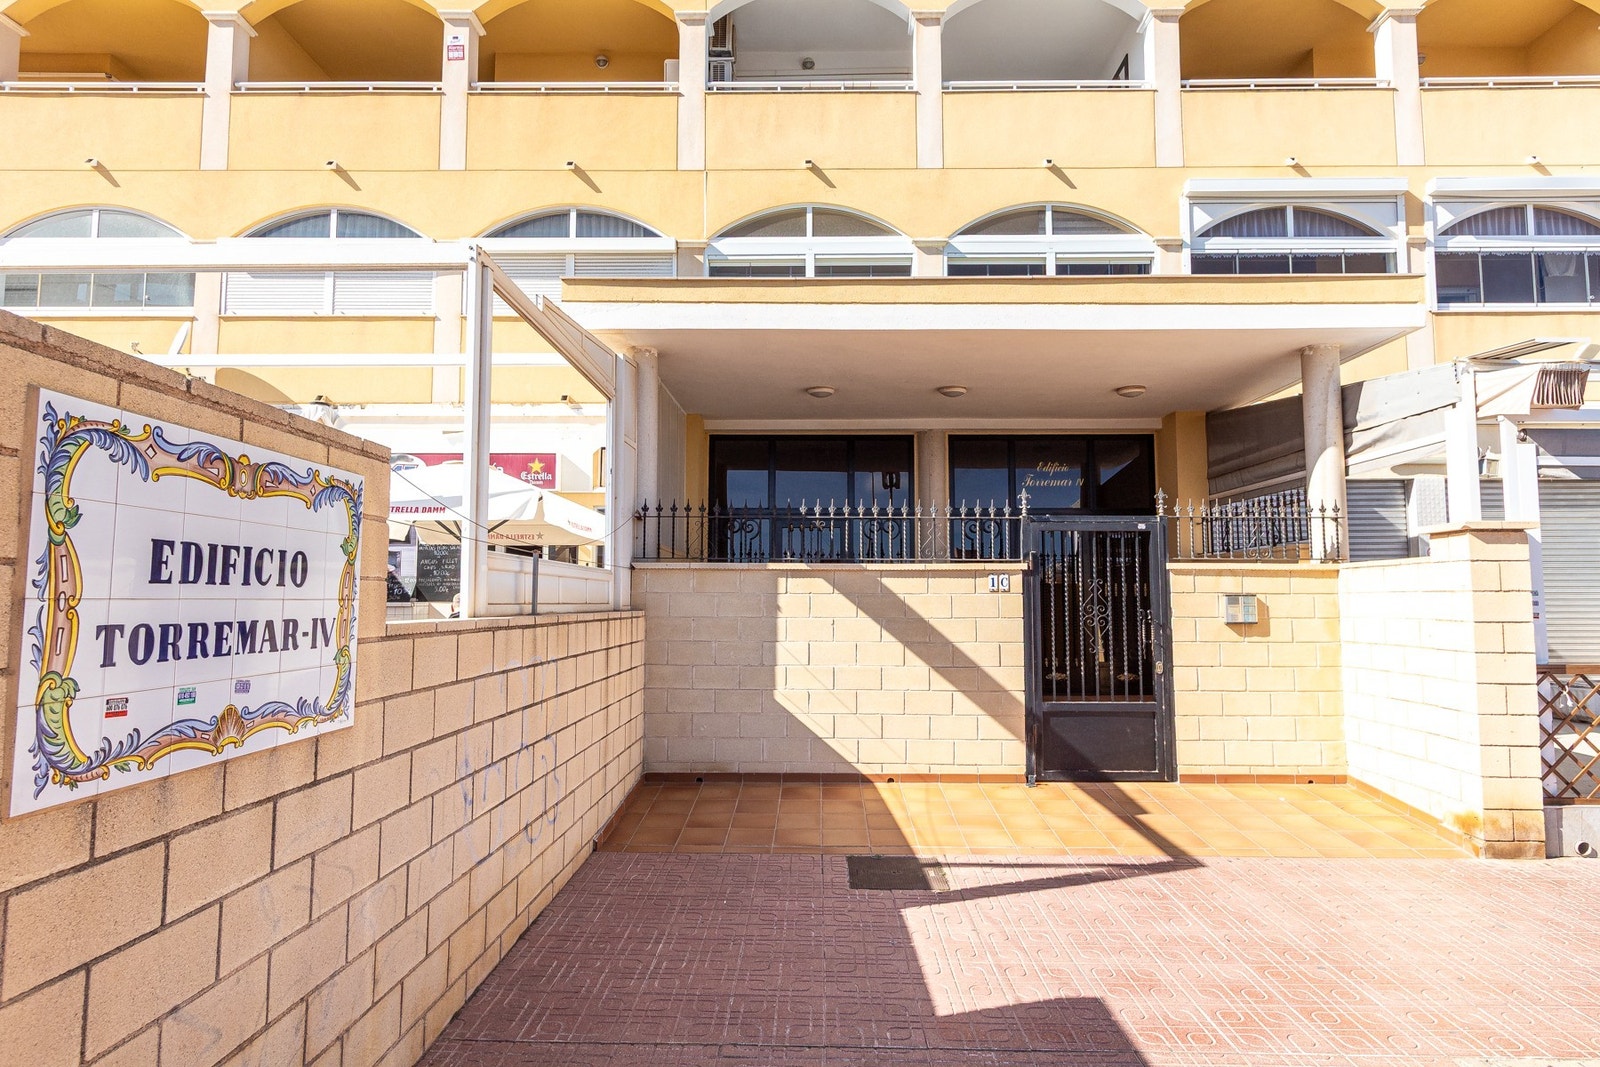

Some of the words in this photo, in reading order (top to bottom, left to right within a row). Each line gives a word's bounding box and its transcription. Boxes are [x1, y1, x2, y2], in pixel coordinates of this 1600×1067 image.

[520, 471, 552, 480] Estrella
[1036, 461, 1069, 476] Edificio
[1021, 474, 1072, 487] Torremar
[148, 538, 308, 588] EDIFICIO
[95, 617, 336, 668] TORREMAR-IV
